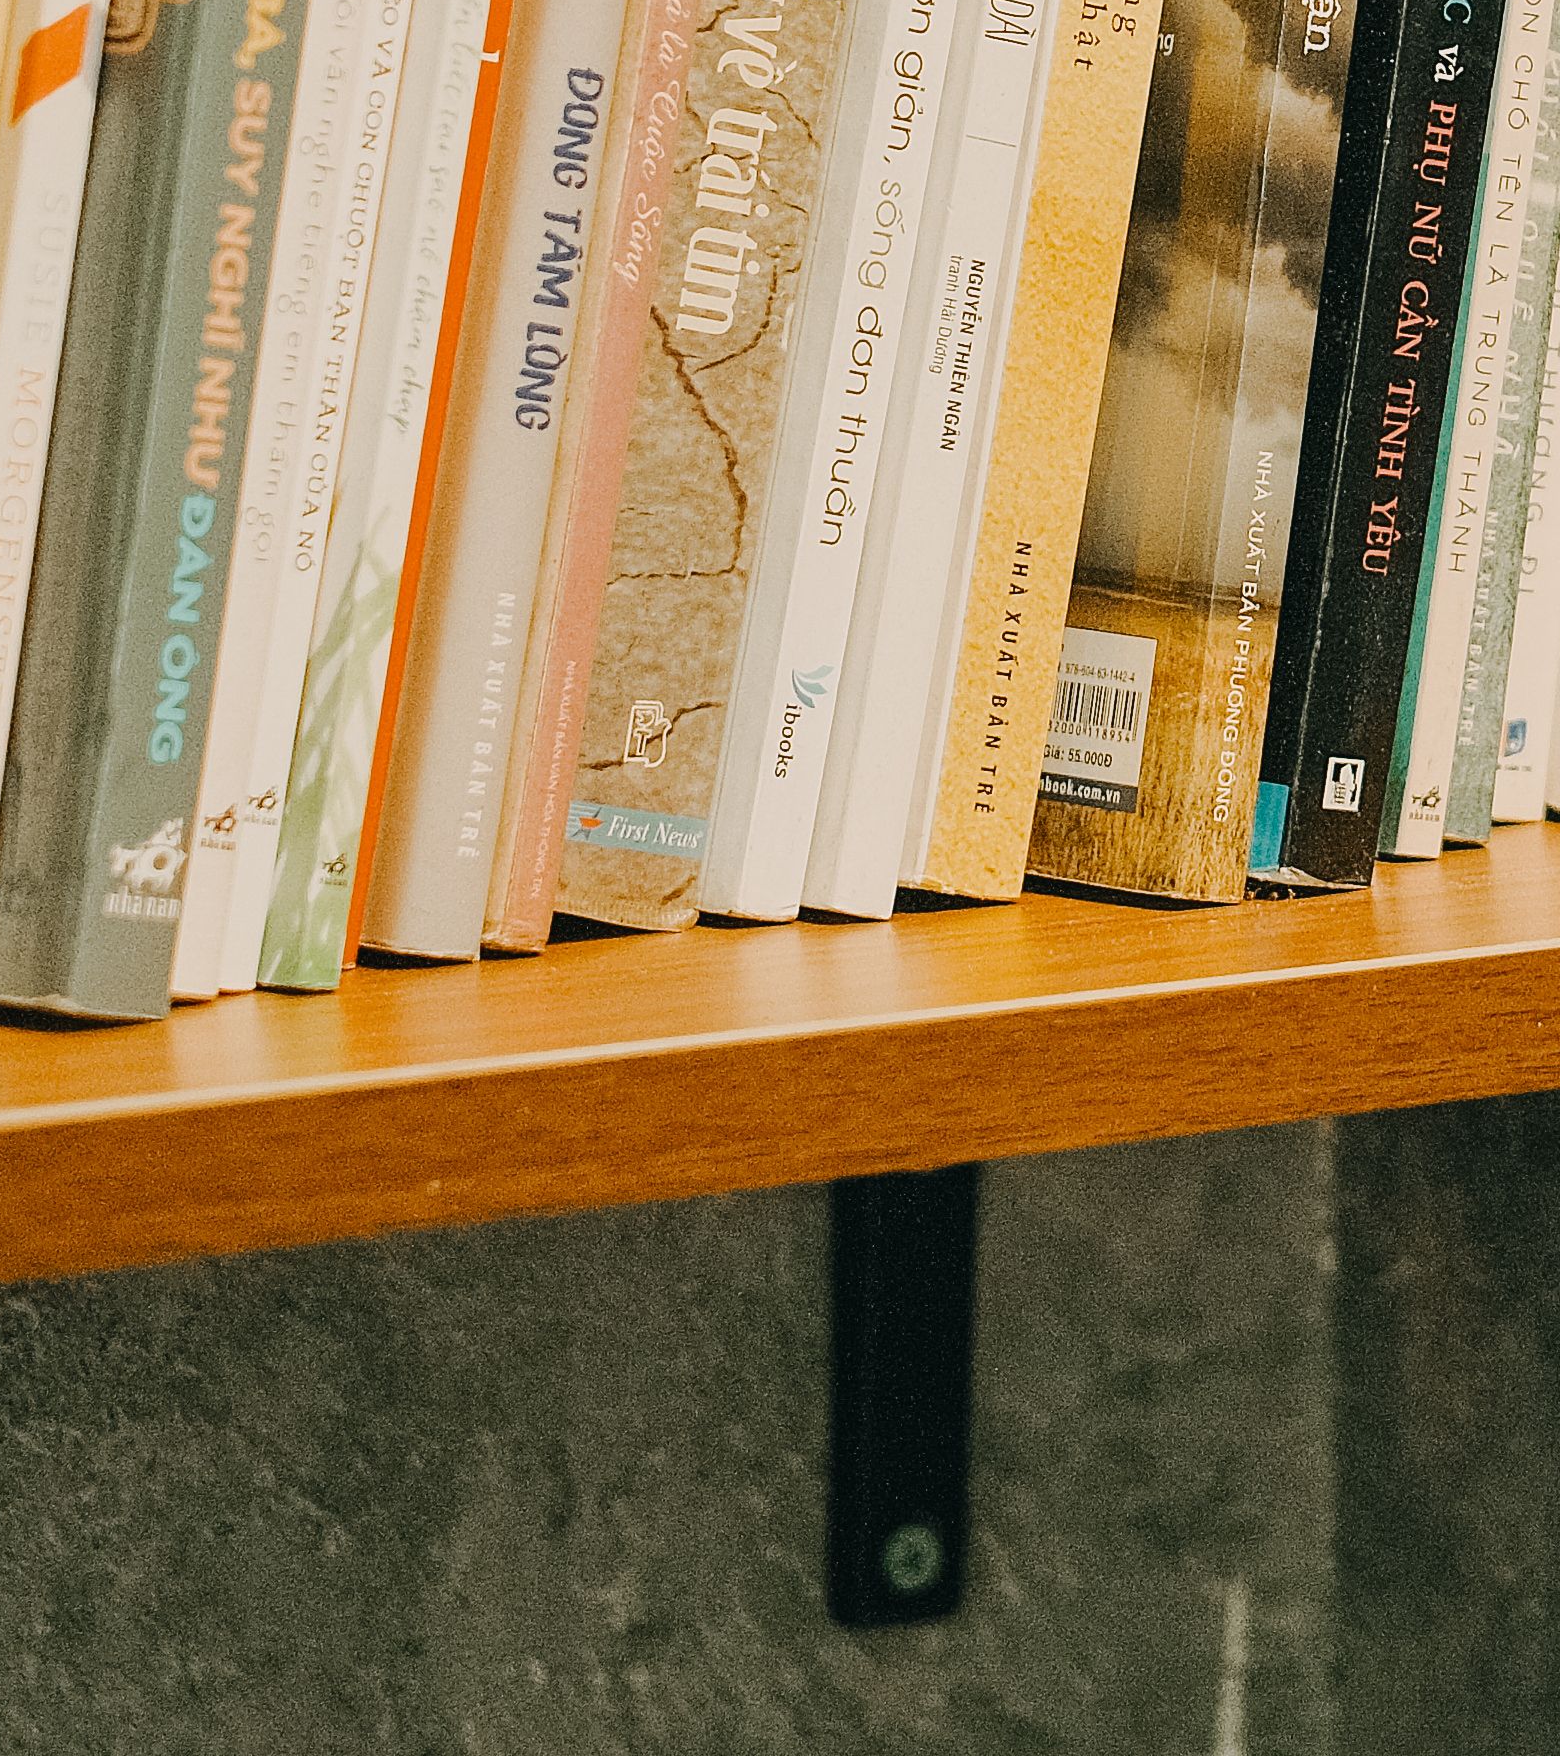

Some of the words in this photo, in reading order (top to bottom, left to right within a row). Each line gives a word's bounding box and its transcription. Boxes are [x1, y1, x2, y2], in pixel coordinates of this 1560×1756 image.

[371, 39, 393, 79] VÀ
[658, 30, 688, 64] là
[717, 4, 797, 96] về
[1433, 44, 1464, 83] và
[360, 89, 384, 152] CON
[552, 68, 604, 189] ĐONG
[875, 47, 937, 171] giản,
[1507, 54, 1534, 131] CHÓ
[629, 75, 685, 184] Cuộc
[697, 104, 776, 217] trái
[1413, 101, 1458, 185] PHỤ
[334, 160, 376, 271] CHUỘT
[1495, 154, 1522, 222] TÊN
[533, 210, 583, 308] TẤM
[613, 192, 661, 282] Sống
[857, 179, 905, 290] sống
[1407, 202, 1444, 265] NỮ
[1486, 243, 1509, 286] LÀ
[676, 227, 759, 334] tim
[940, 297, 958, 322] Hải
[946, 254, 964, 293] tranh
[960, 259, 986, 335] NGUYỄN
[330, 279, 355, 344] BẠN
[1393, 280, 1439, 360] CẦN
[514, 323, 566, 430] LÒNG
[845, 305, 883, 396] đơn
[928, 325, 953, 375] Dương
[949, 342, 973, 395] THIÊN
[1467, 311, 1501, 427] TRUNG
[314, 360, 342, 443] THÂN
[939, 399, 962, 451] NGÂN
[1375, 378, 1420, 479] TÌNH
[301, 453, 330, 518] CỦA
[820, 415, 867, 546] thuần
[1249, 449, 1281, 505] NHÀ
[1449, 452, 1482, 573] THÀNH
[291, 527, 320, 575] NÓ
[1008, 541, 1033, 596] NHÀ
[1239, 508, 1275, 576] XUẤT
[1361, 497, 1402, 576] YÊU
[1235, 582, 1264, 632] BẢN
[995, 610, 1022, 681] XUẤT
[984, 694, 1009, 749] BẢN
[1218, 639, 1250, 742] PHƯƠNG
[774, 704, 801, 778] ibooks
[974, 765, 998, 813] TRẺ
[1208, 750, 1236, 822] ĐÔNG
[606, 814, 650, 844] First
[653, 821, 703, 850] News
